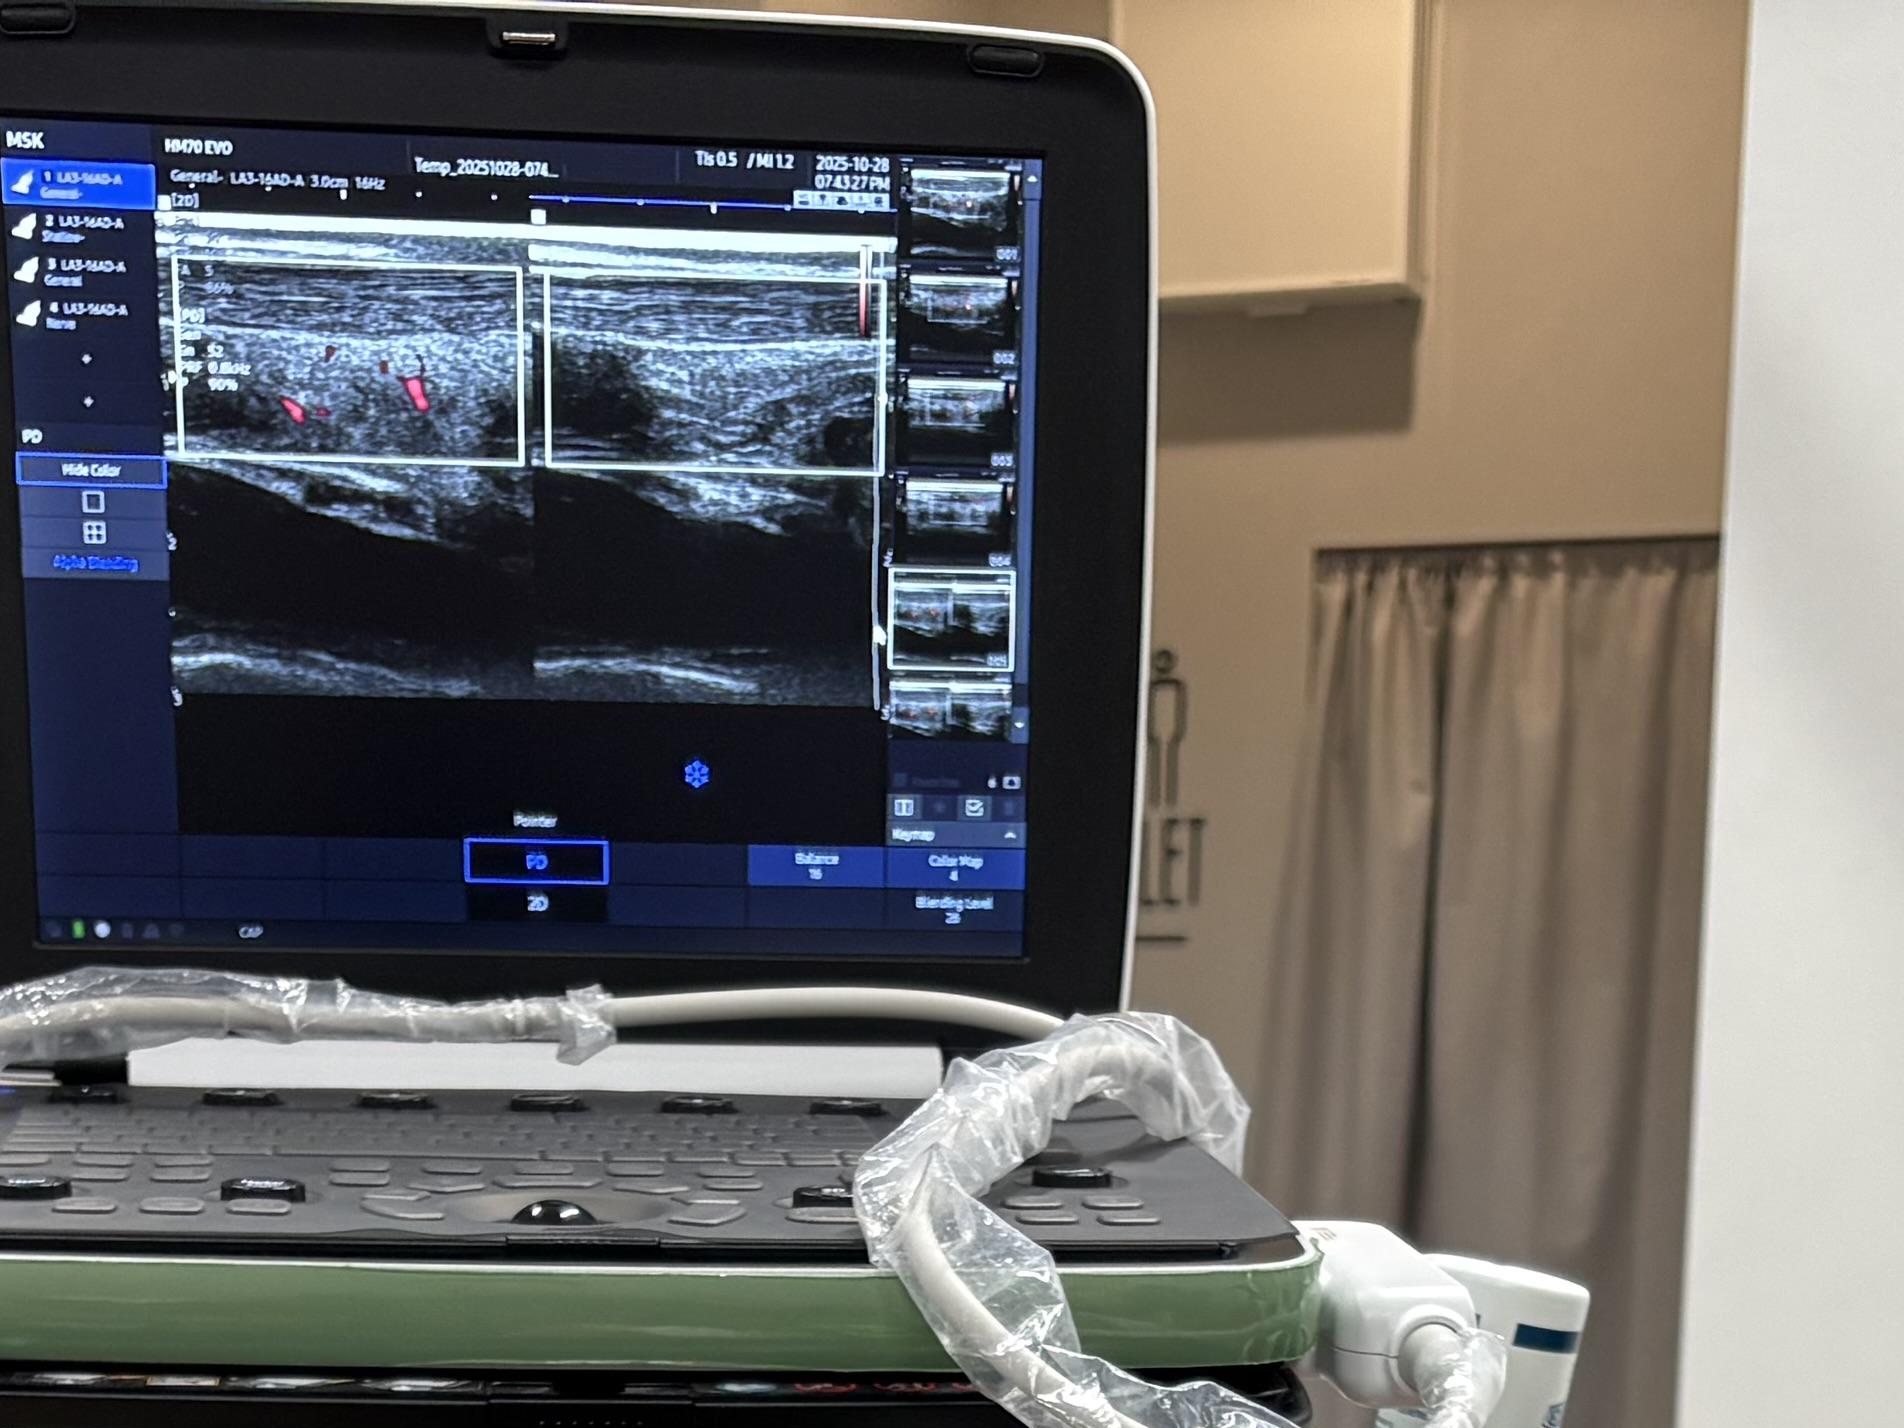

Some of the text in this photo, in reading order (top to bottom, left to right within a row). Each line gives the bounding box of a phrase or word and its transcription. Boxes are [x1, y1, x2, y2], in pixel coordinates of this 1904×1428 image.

[6, 131, 45, 149] MSK
[164, 138, 234, 155] HM70 EVO
[716, 151, 738, 167] 0.5
[775, 153, 795, 169] 1.2
[815, 155, 890, 173] 2025-10-28
[309, 174, 349, 189] 3.0cm
[21, 428, 43, 444] PD
